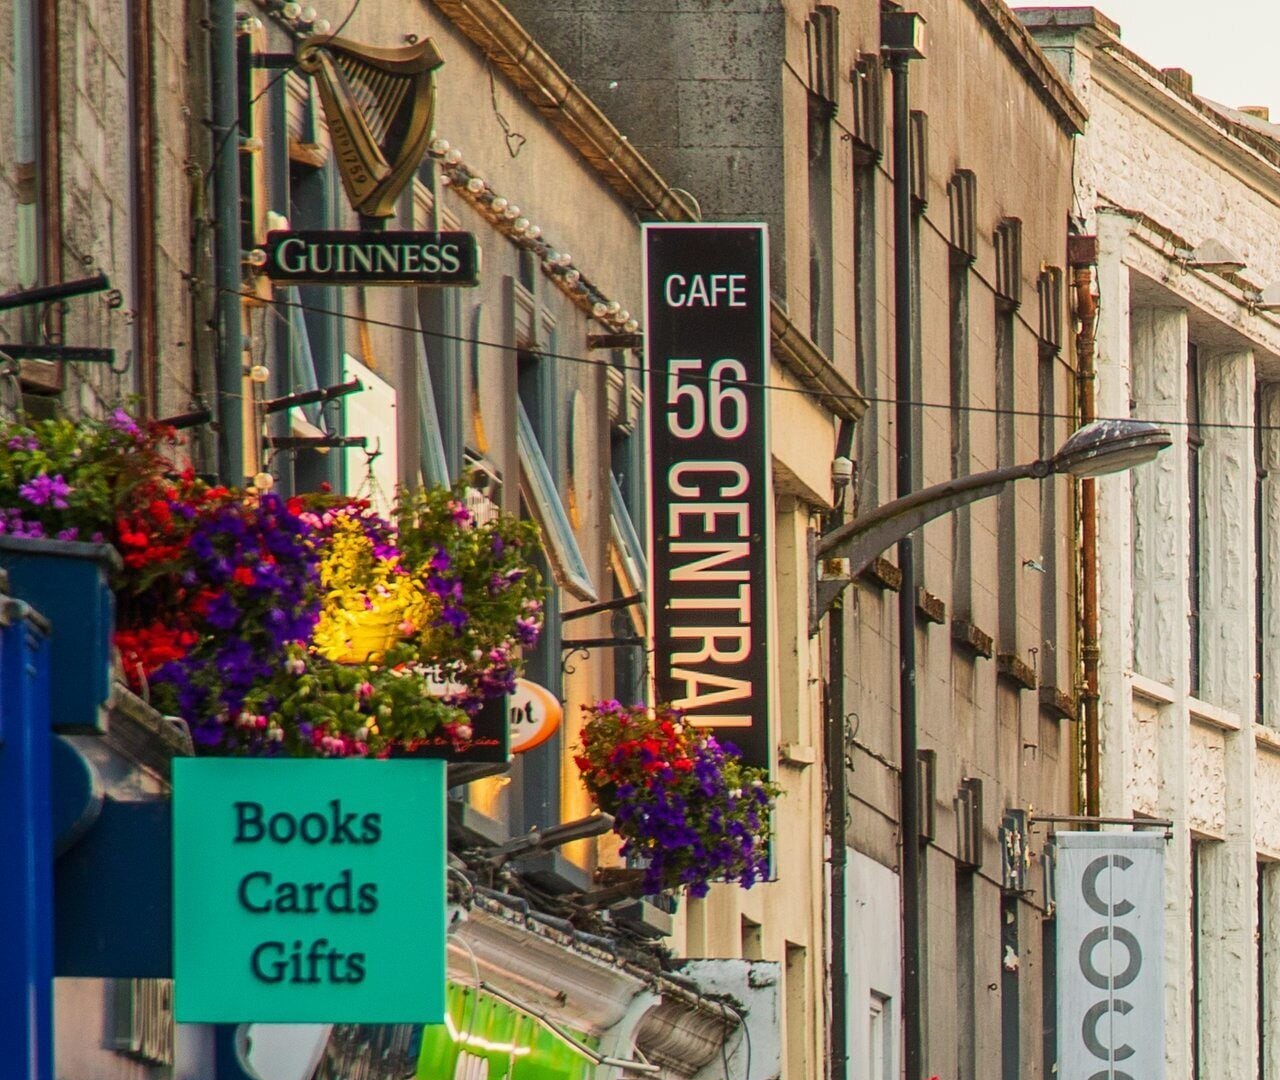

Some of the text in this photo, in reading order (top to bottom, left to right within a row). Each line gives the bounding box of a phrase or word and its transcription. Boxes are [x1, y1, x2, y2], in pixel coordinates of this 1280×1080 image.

[276, 238, 460, 273] GUINNESS
[665, 274, 747, 308] CAFE
[666, 358, 749, 439] 56
[233, 798, 382, 845] Books
[238, 868, 379, 914] Cards
[251, 938, 366, 985] Gifts
